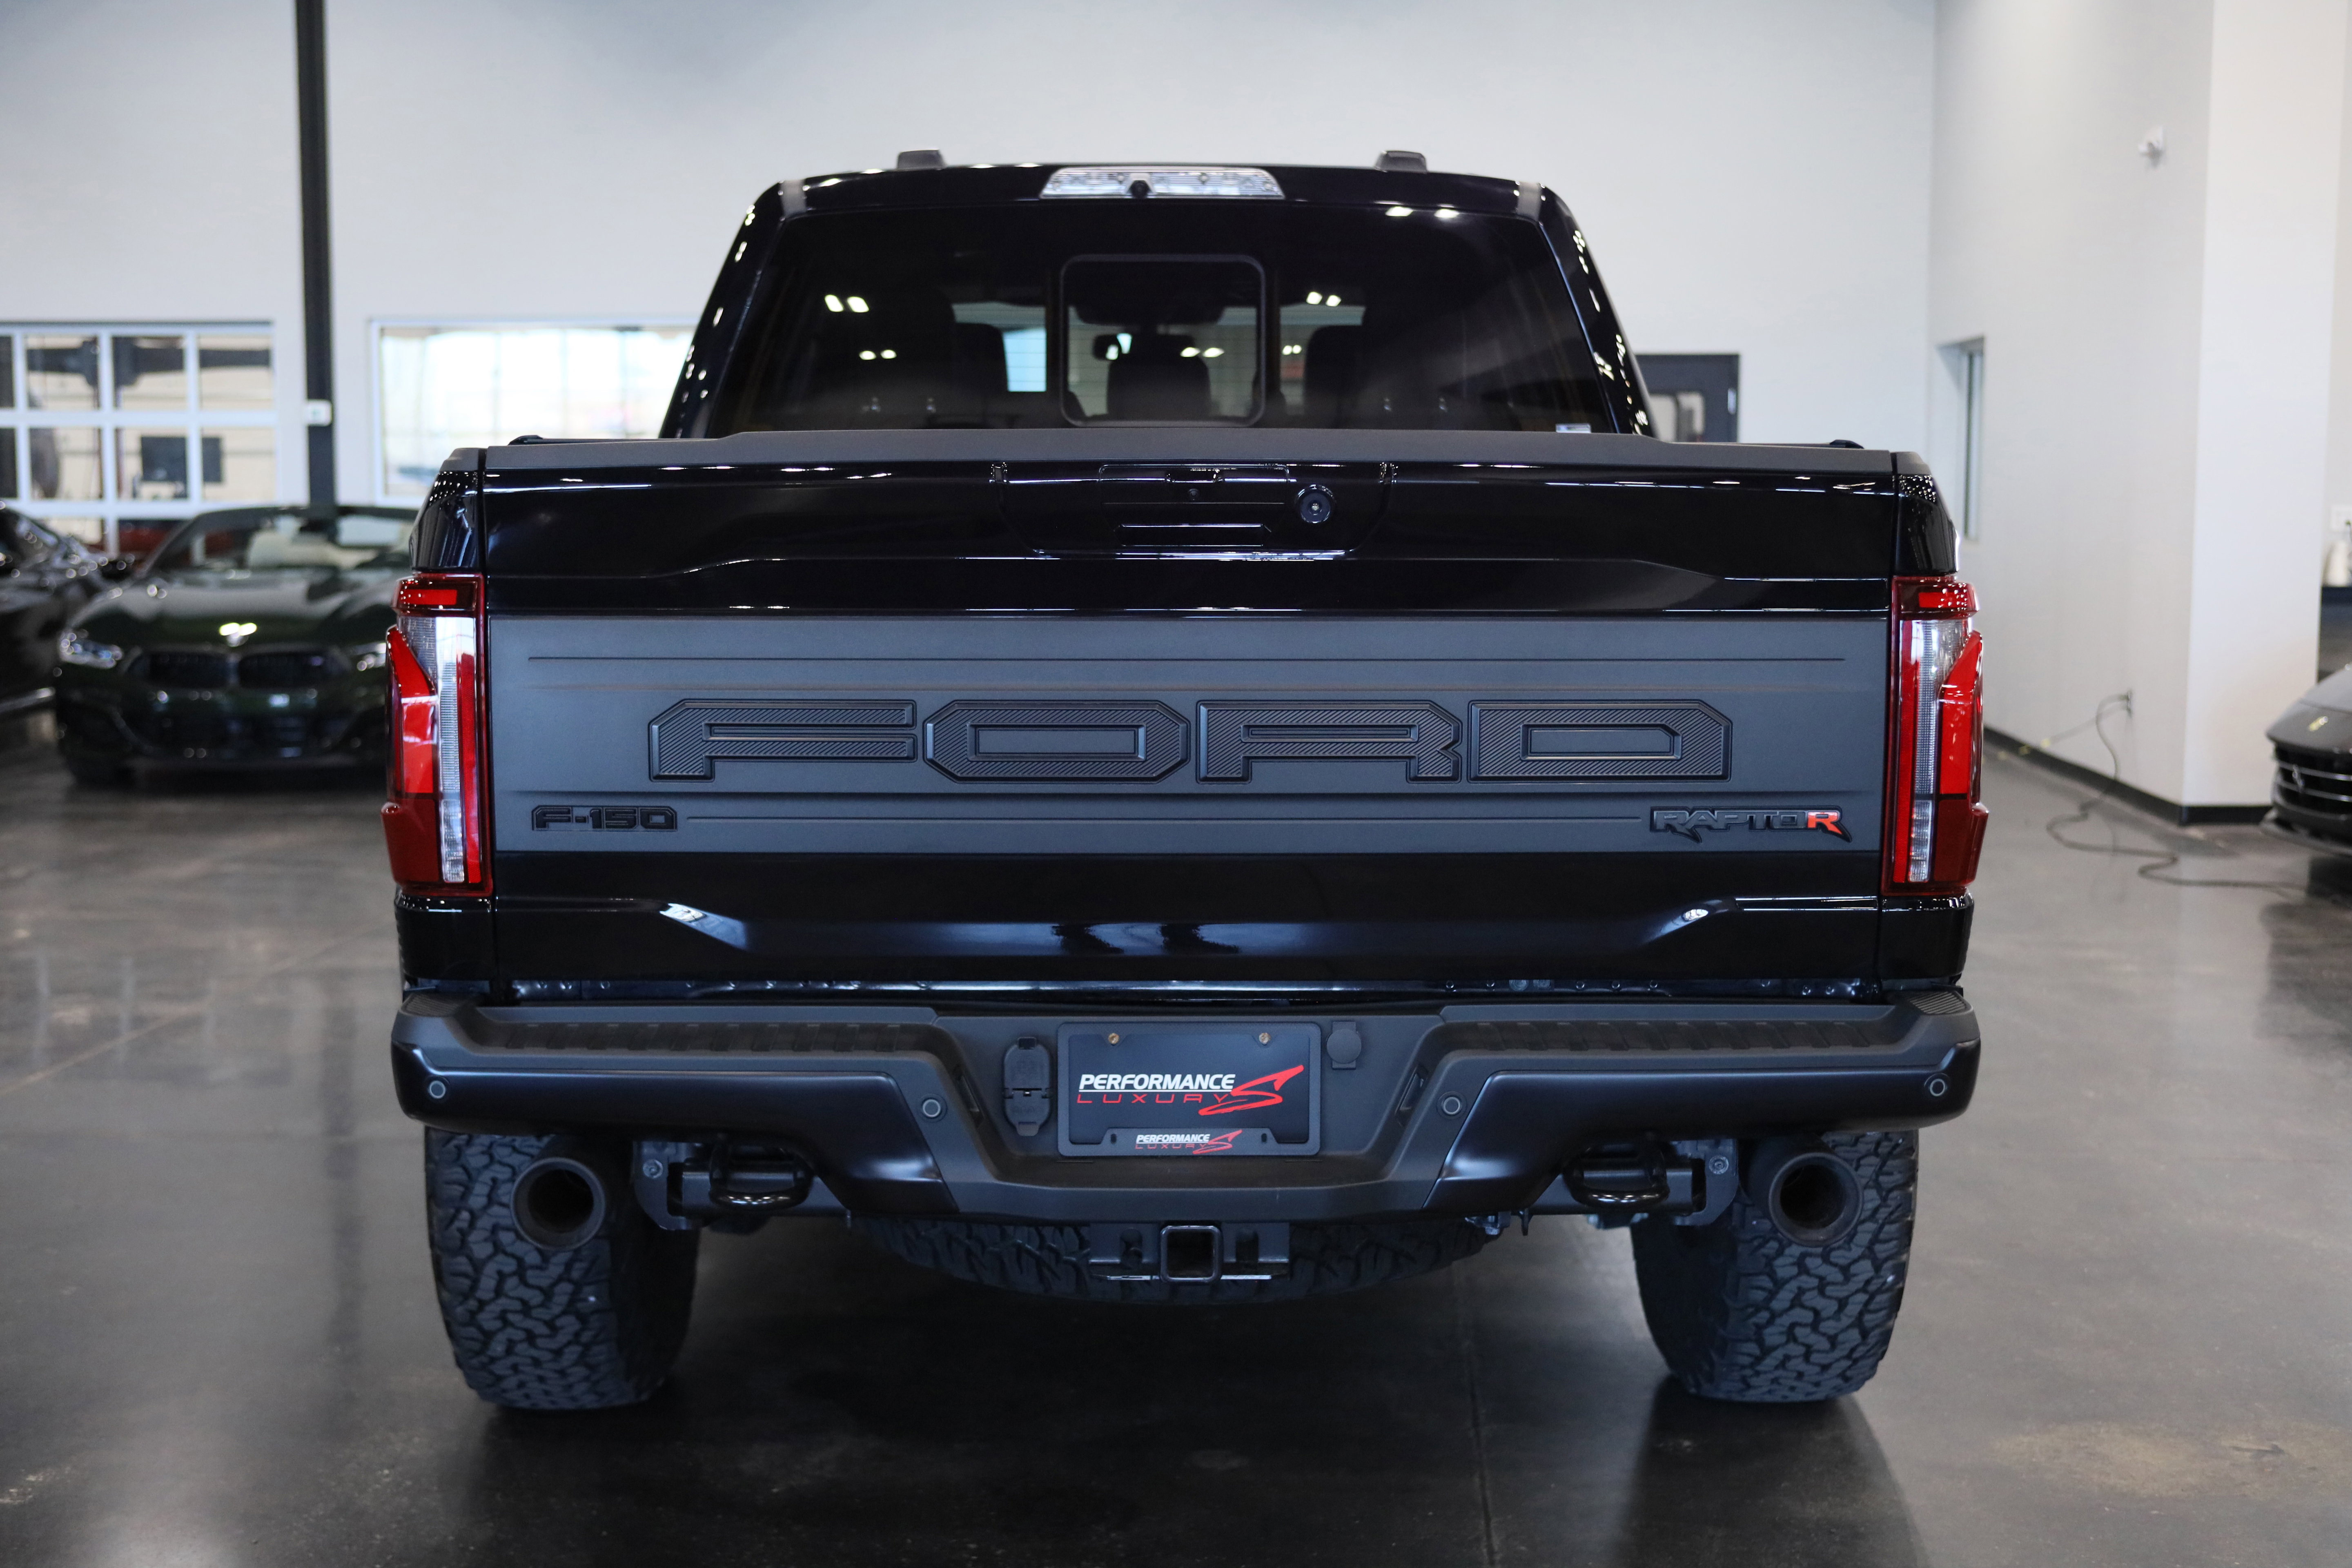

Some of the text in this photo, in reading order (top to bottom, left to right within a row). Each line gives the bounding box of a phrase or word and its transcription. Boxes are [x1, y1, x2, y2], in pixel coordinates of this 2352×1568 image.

[648, 699, 1732, 783] FORD
[532, 805, 678, 831] F-150
[1650, 806, 1851, 843] RAPTOR
[1079, 1074, 1236, 1090] PERFORMANCE
[1077, 1092, 1228, 1103] LUXURY
[1136, 1134, 1210, 1143] PERFORMANCE
